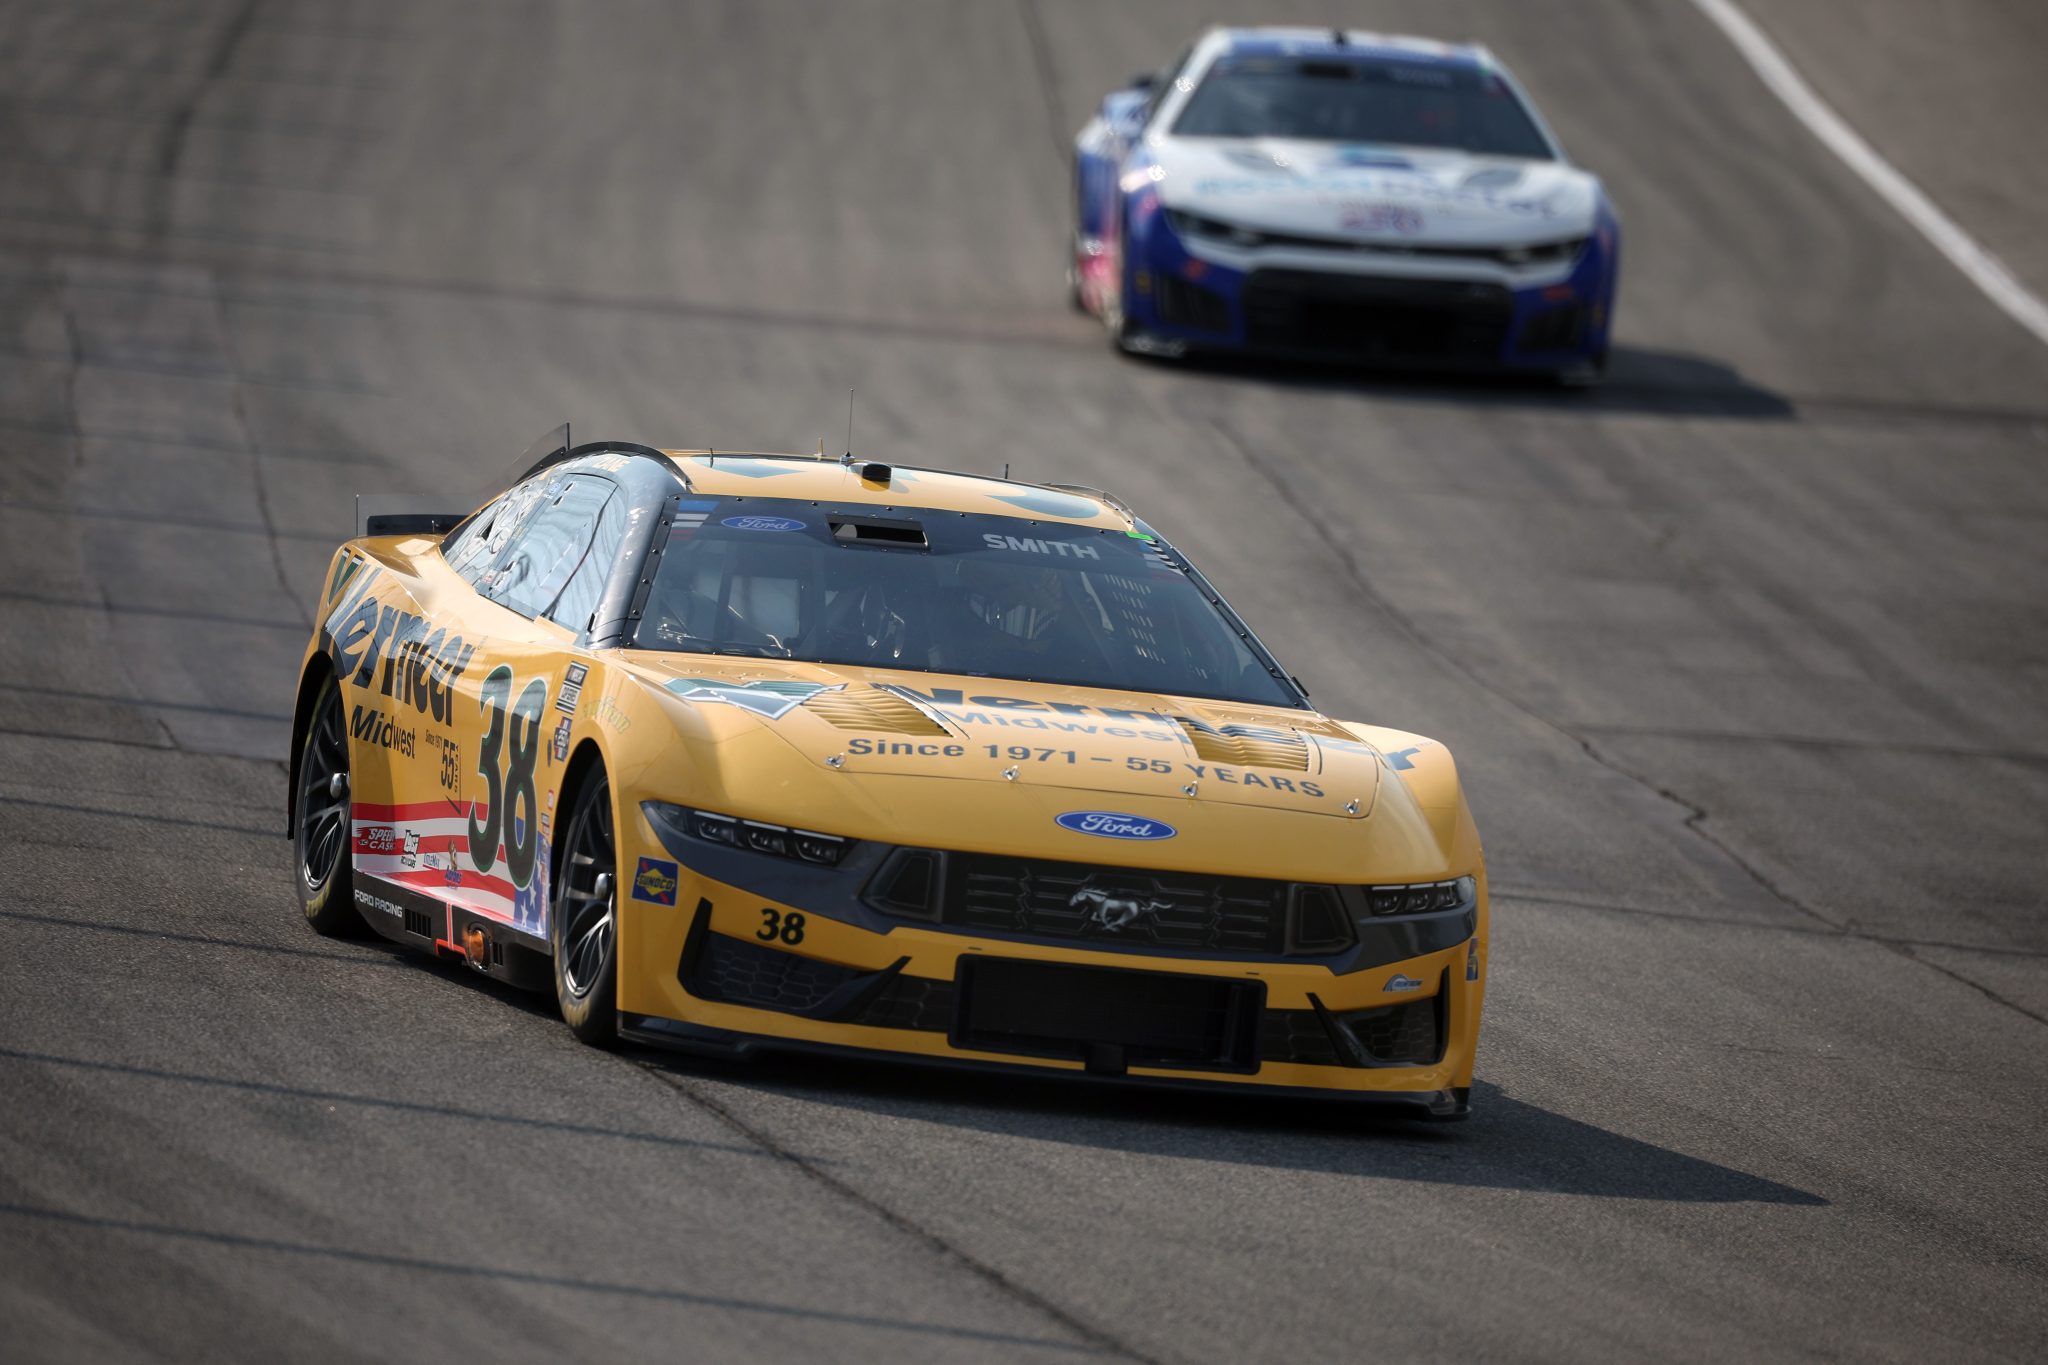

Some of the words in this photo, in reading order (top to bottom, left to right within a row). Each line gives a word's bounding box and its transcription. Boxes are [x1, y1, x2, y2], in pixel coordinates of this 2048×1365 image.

[737, 515, 790, 533] Ford
[981, 533, 1101, 561] SMITH
[350, 704, 416, 760] Midwest
[425, 729, 435, 746] Since
[935, 710, 1191, 744] Midwest
[441, 738, 456, 790] 55
[469, 665, 547, 890] 38
[848, 738, 966, 758] Since
[983, 745, 1076, 764] 1971
[1126, 757, 1173, 775] 55
[1184, 763, 1326, 798] YEARS
[1080, 812, 1153, 839] Ford
[638, 874, 674, 891] SUNOCO
[354, 889, 375, 907] FORD
[374, 896, 403, 918] RACING
[756, 907, 806, 946] 38
